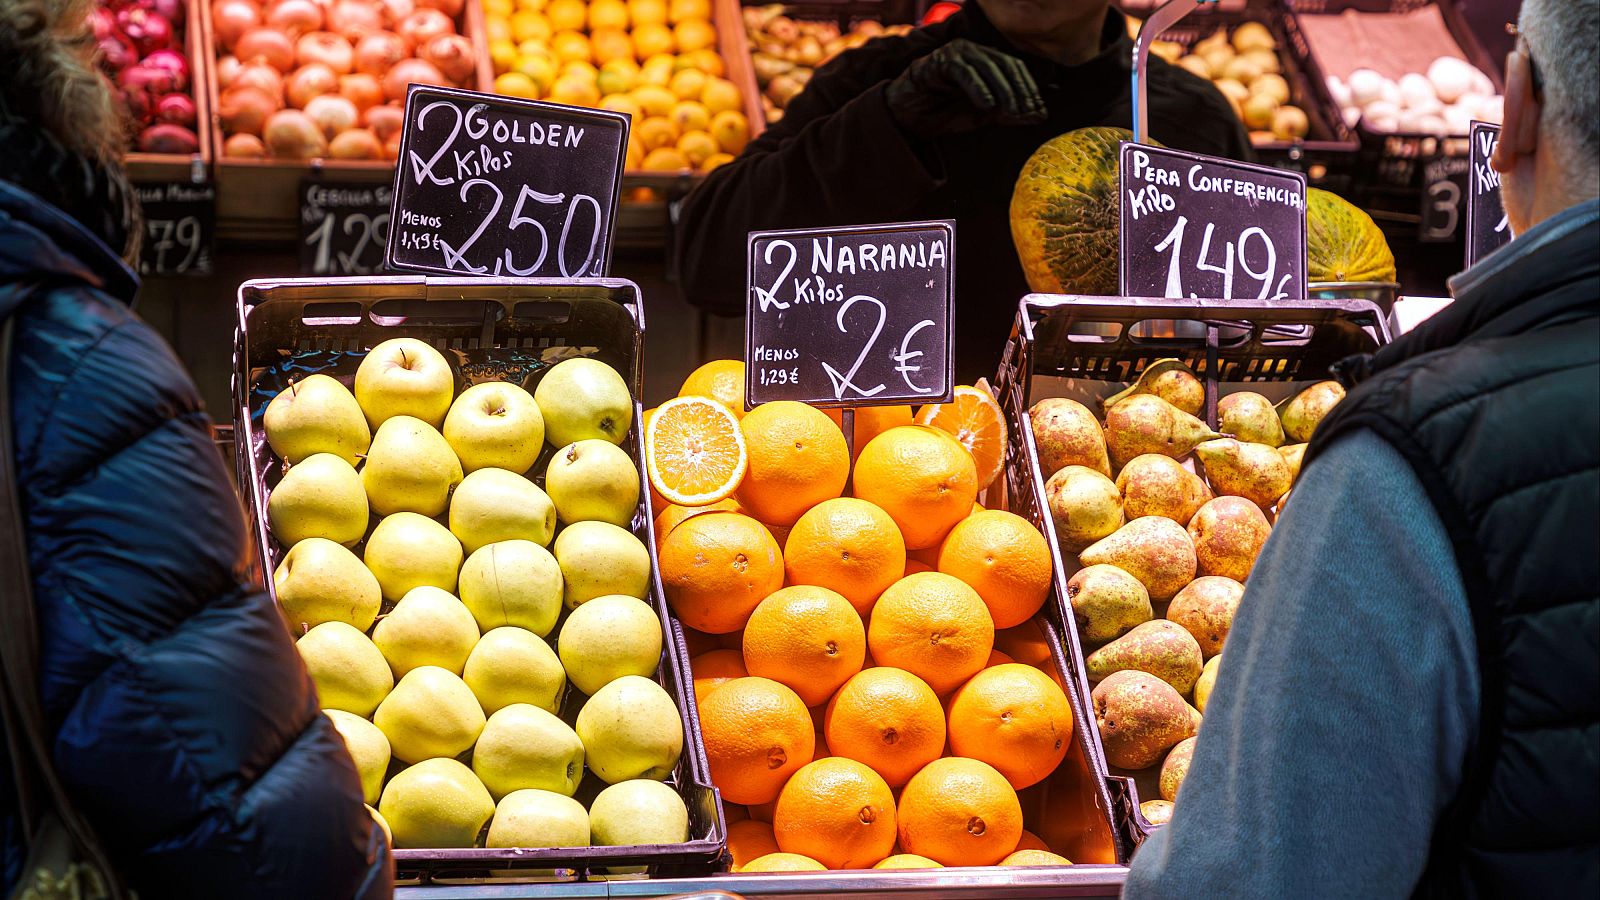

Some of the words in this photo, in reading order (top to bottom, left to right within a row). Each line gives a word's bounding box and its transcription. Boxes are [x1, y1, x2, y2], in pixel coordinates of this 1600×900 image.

[410, 101, 456, 185] 2
[464, 104, 584, 147] GOLDEN
[1133, 150, 1181, 187] PERA
[1187, 164, 1303, 211] CONFERENCIA
[400, 209, 442, 228] MENOS
[811, 236, 946, 274] NARANJA
[755, 239, 797, 313] 2
[754, 345, 799, 361] MENOS
[760, 367, 799, 386] 1,29€
